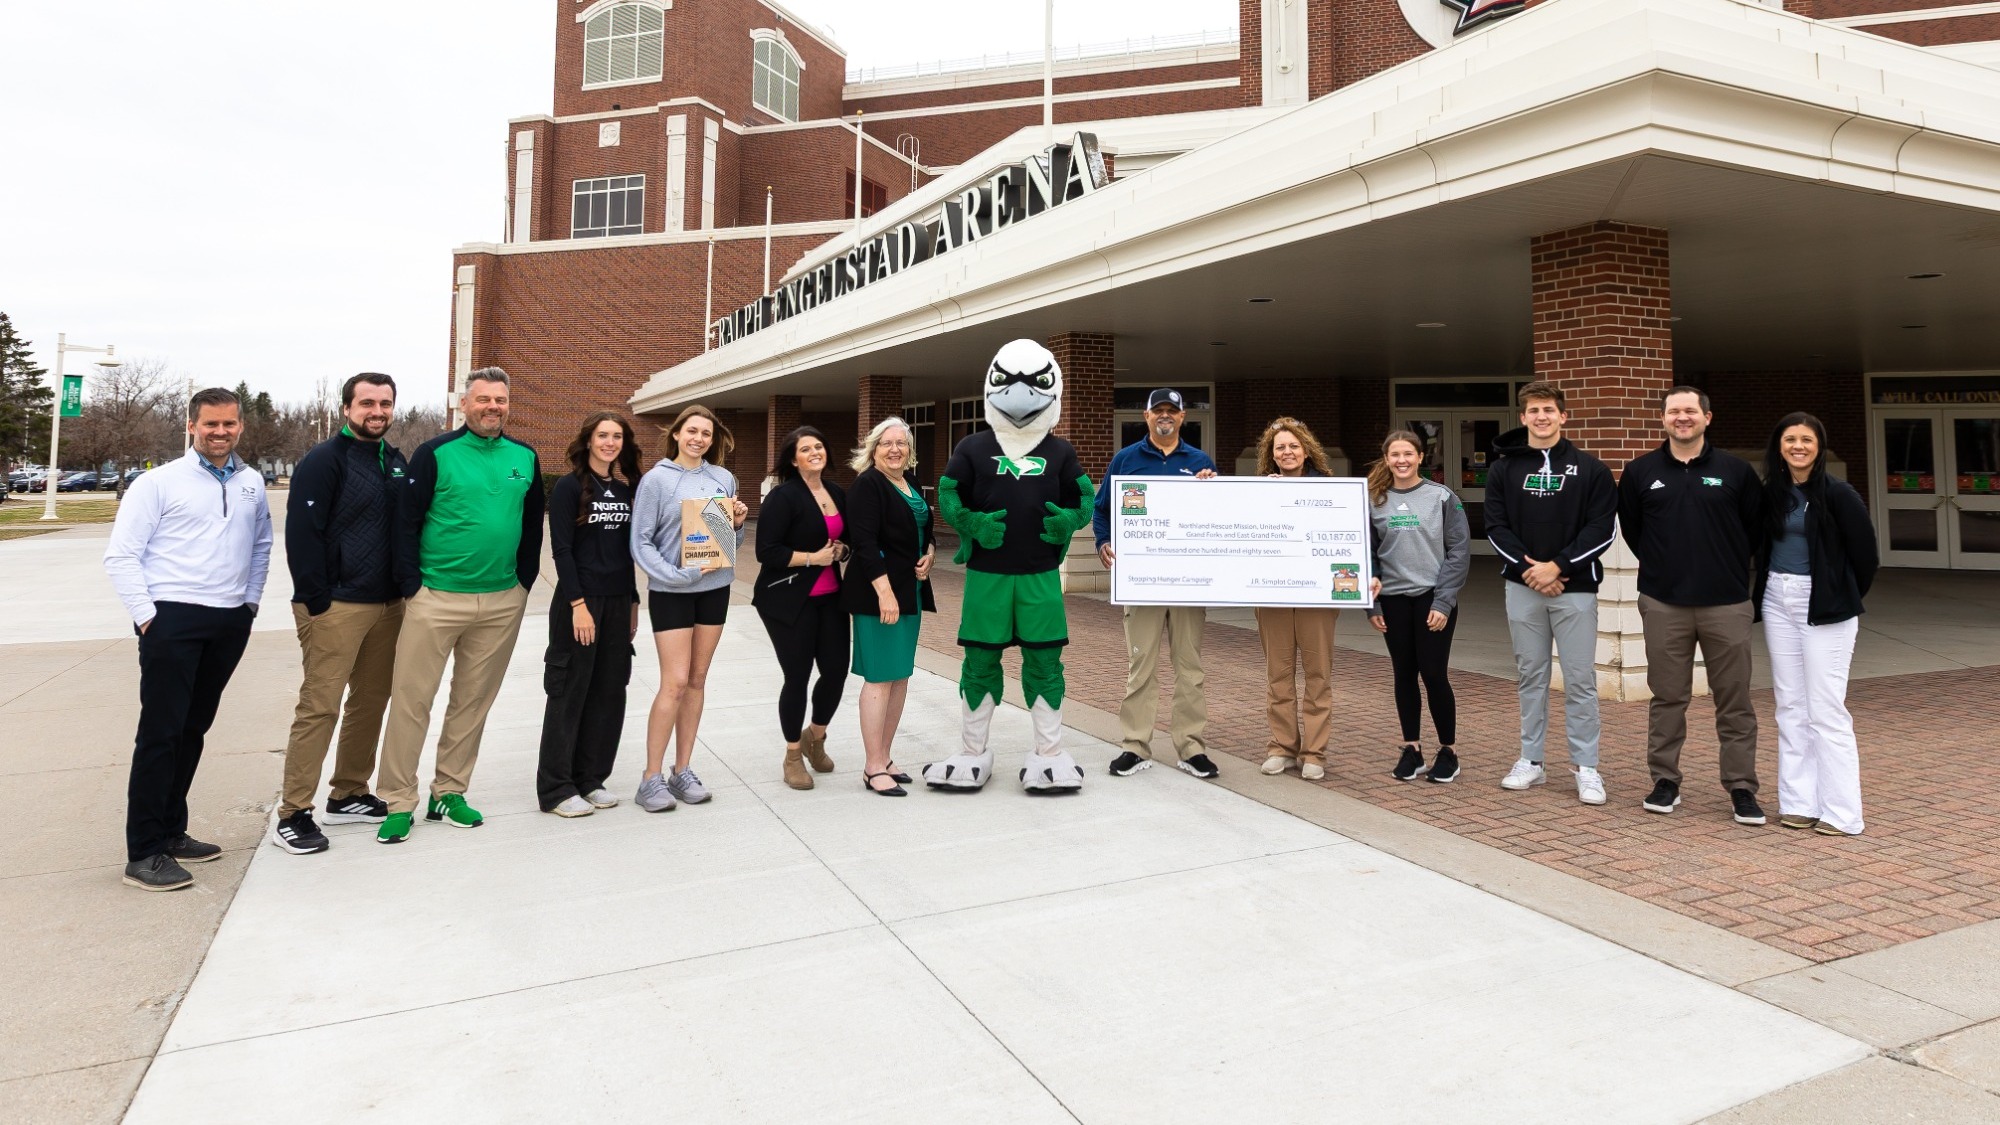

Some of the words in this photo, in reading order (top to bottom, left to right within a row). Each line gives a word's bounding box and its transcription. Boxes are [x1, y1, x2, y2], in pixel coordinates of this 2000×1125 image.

[718, 297, 771, 347] RALPH
[773, 222, 924, 326] ENGELSTAD
[933, 131, 1108, 257] ARENA
[1924, 391, 1961, 402] CALL
[990, 455, 1047, 480] ND
[1564, 464, 1578, 476] 21
[1294, 499, 1334, 507] 4/17/2025
[588, 512, 631, 524] DAKOT
[1123, 518, 1139, 527] PAY
[1140, 518, 1153, 527] TO
[1155, 519, 1171, 528] THE
[1178, 522, 1210, 530] Northland
[1259, 523, 1281, 531] United
[1281, 524, 1295, 532] Way
[1123, 530, 1153, 539] ORDER
[1154, 530, 1167, 539] OF
[1185, 531, 1206, 539] Grand
[1206, 531, 1223, 539] Forks
[1250, 532, 1270, 540] Grand
[1305, 532, 1311, 541] $
[1317, 533, 1357, 542] 10,187.00
[684, 550, 720, 559] CHAMPION
[1157, 546, 1187, 554] thousand
[1201, 546, 1228, 554] hundred
[1242, 547, 1262, 556] eighty
[1311, 548, 1352, 557] DOLLARS
[1127, 575, 1157, 584] Stopping
[1157, 575, 1181, 584] Hunger
[1181, 576, 1213, 585] Campaign
[1261, 578, 1286, 587] Simplot
[1286, 579, 1317, 588] Company
